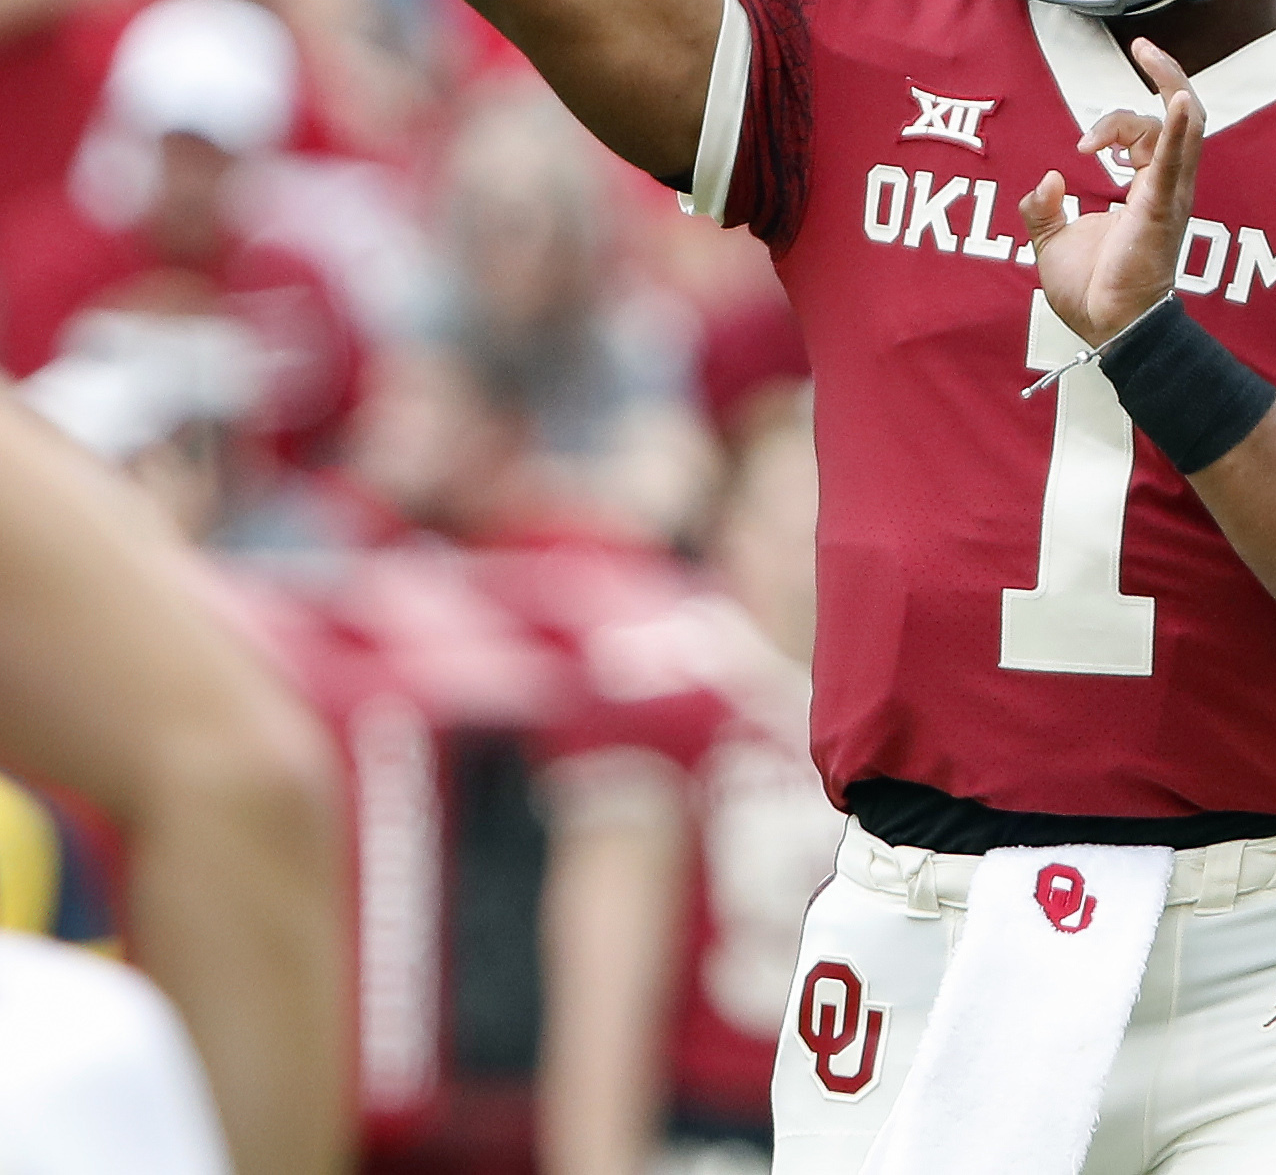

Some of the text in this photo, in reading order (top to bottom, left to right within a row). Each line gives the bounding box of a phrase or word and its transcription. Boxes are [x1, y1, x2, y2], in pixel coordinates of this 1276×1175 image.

[900, 85, 996, 149] XII
[998, 287, 1156, 678] 1
[1034, 862, 1098, 934] OU
[797, 957, 888, 1098] OU
